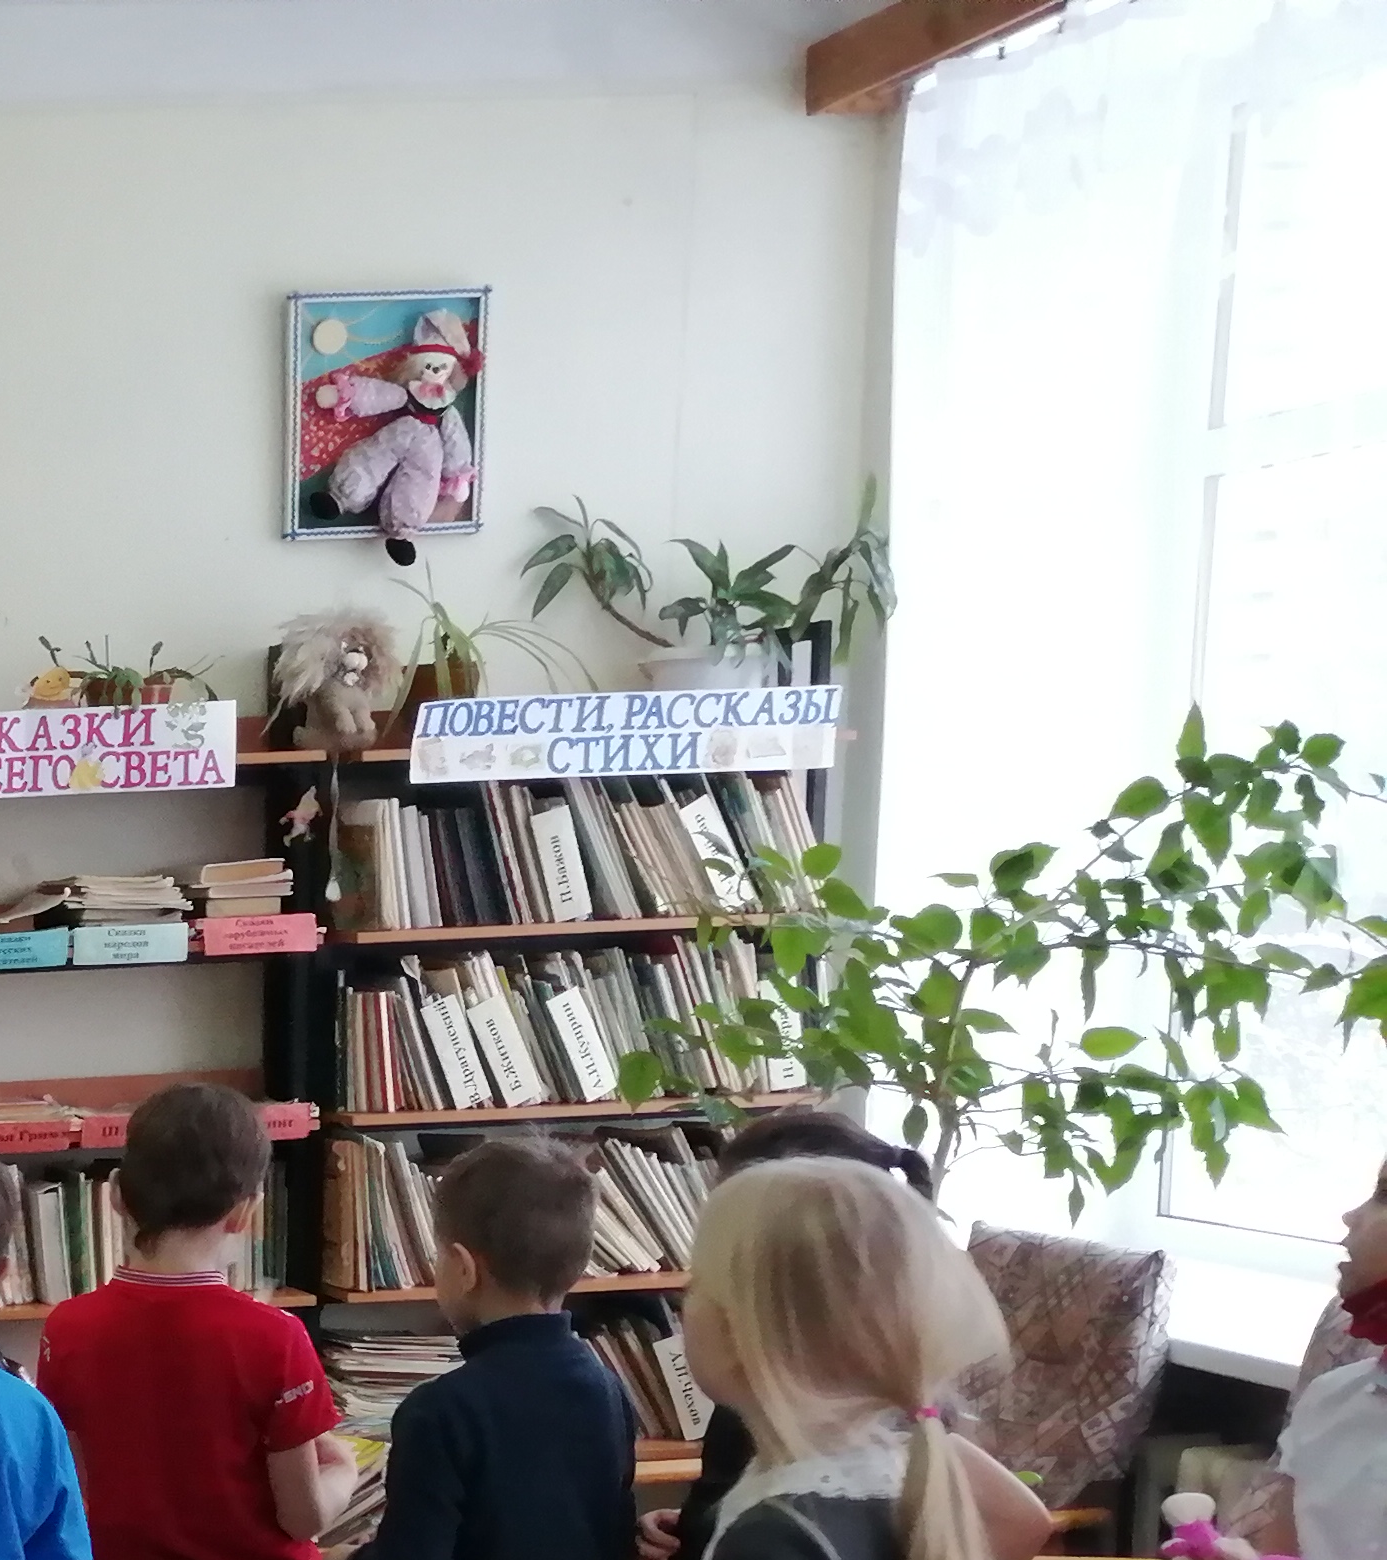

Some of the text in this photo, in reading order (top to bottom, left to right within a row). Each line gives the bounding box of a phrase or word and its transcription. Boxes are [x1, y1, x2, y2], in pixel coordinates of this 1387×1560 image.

[417, 688, 839, 740] ПОВЕСТИ, РАССКАЗЫ
[97, 749, 225, 790] СВЕТА
[547, 732, 702, 775] СТИХИ
[550, 834, 574, 904] П.Бажов
[485, 1018, 522, 1092] Б.Житков
[562, 1002, 604, 1089] А.И.Куприн
[669, 1352, 701, 1425] А.П.Чехов
